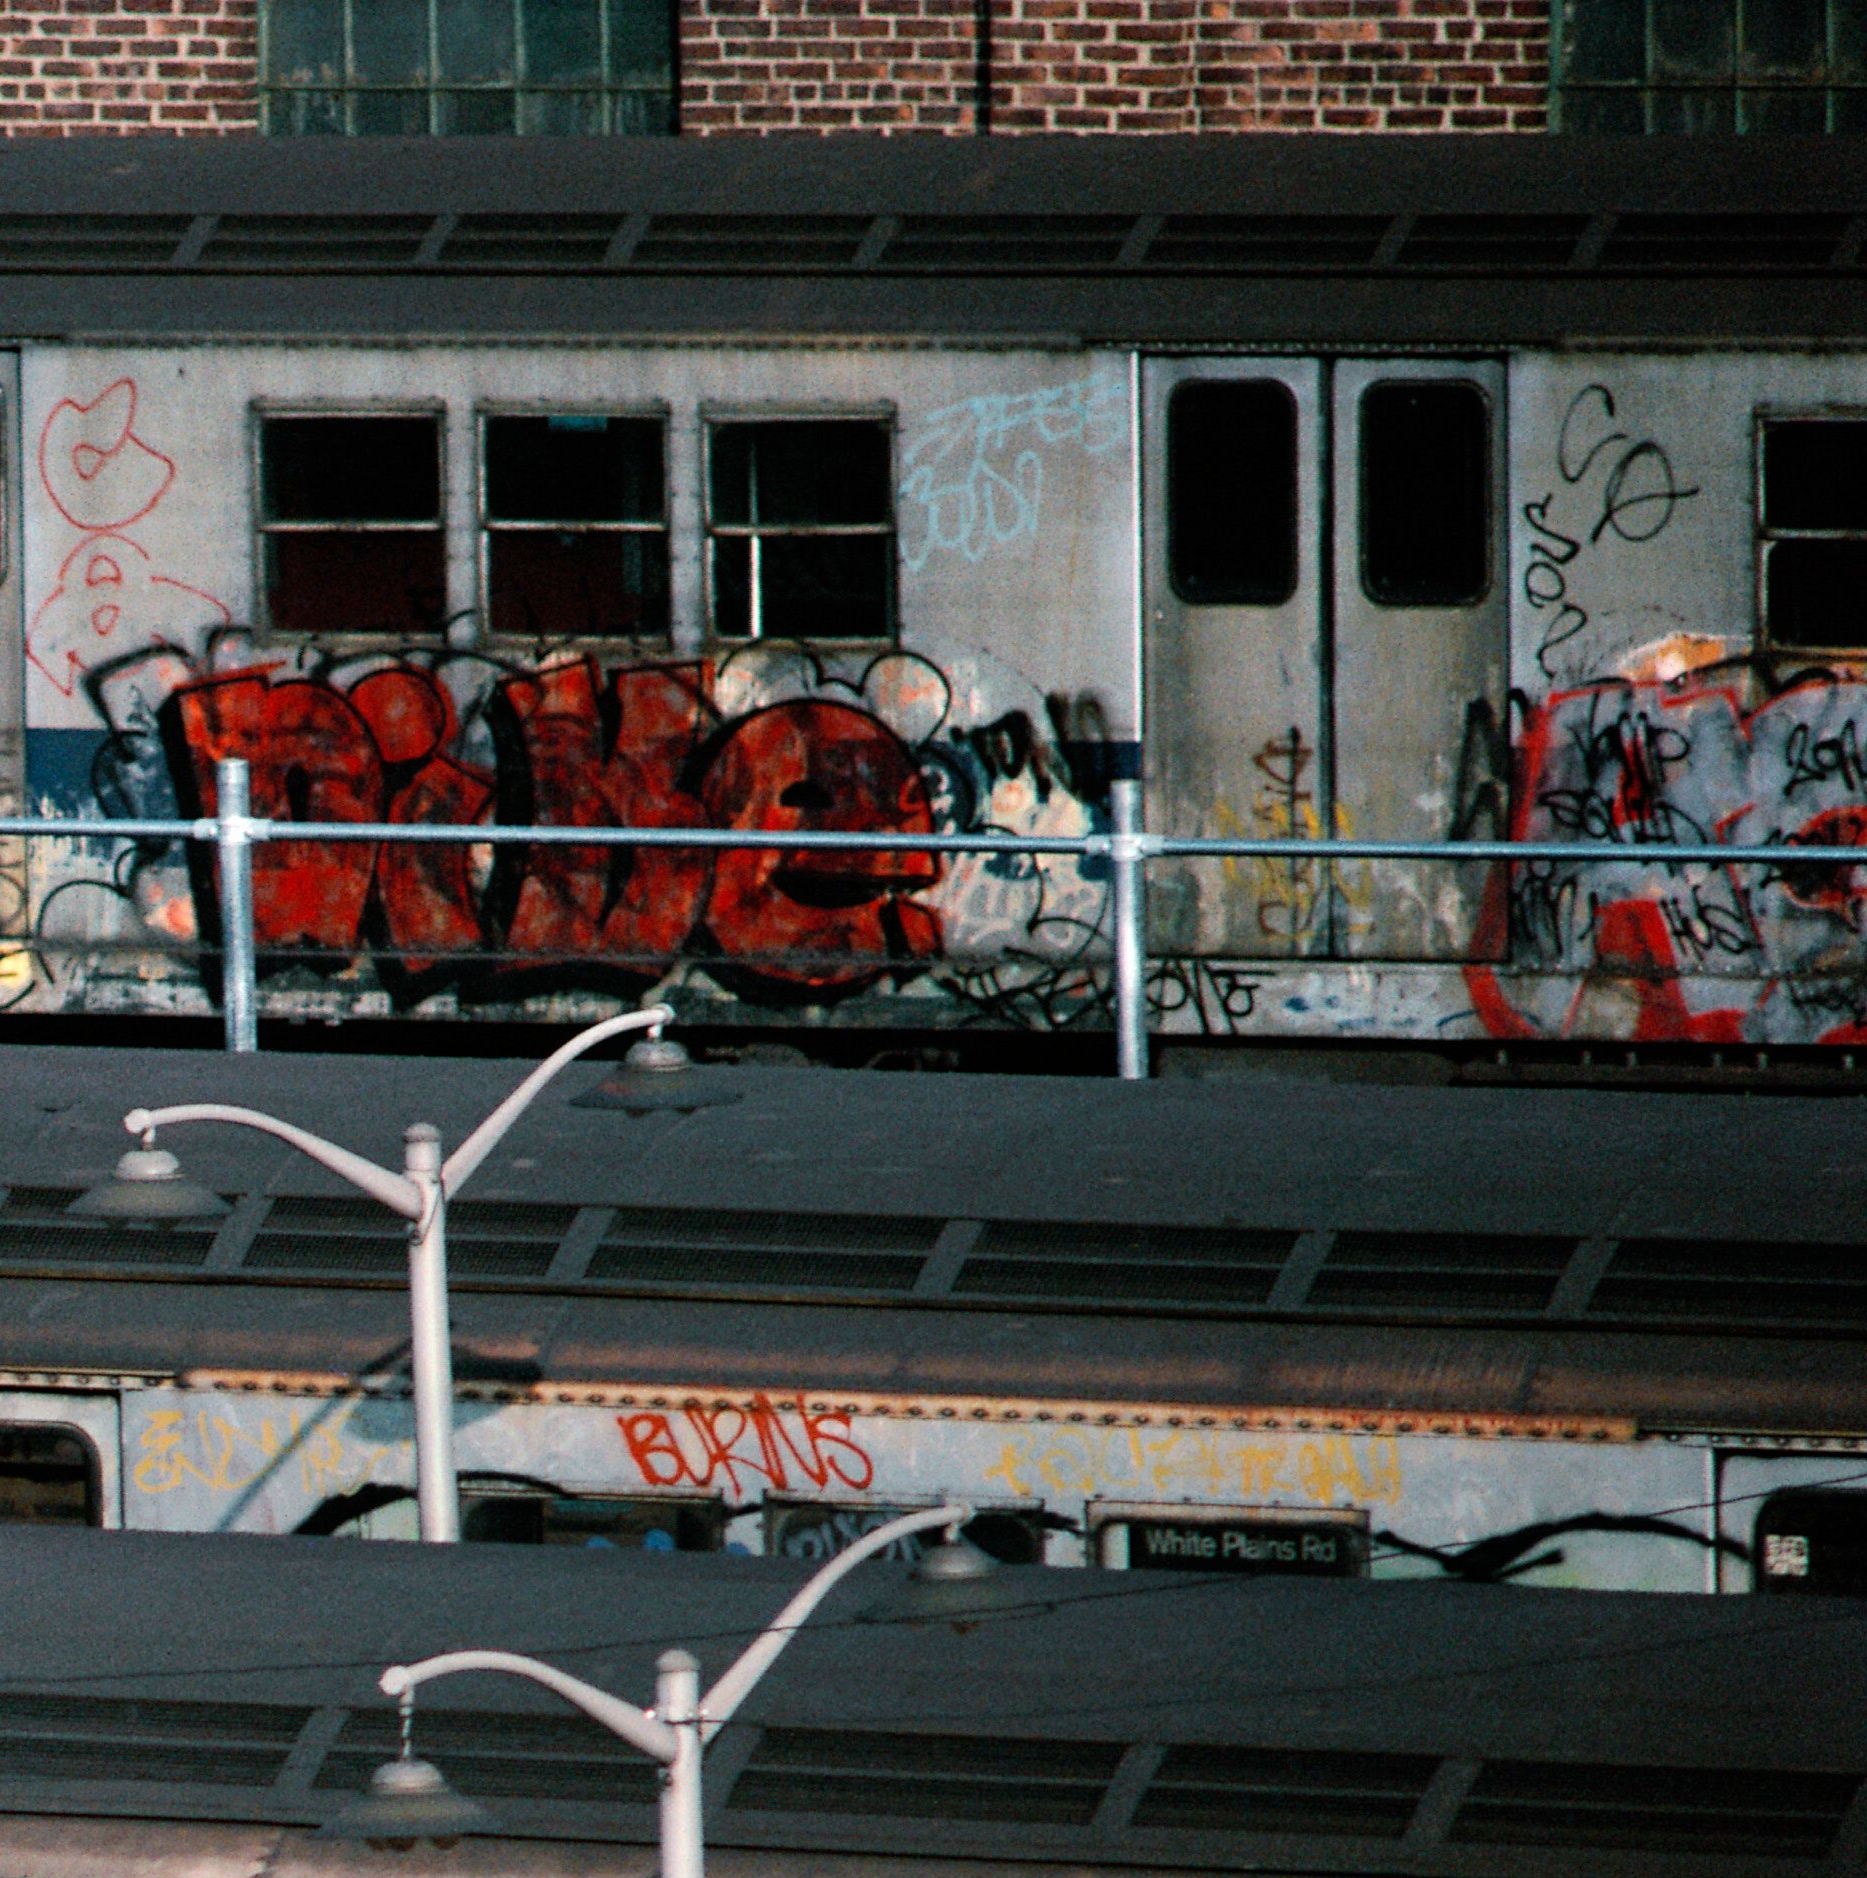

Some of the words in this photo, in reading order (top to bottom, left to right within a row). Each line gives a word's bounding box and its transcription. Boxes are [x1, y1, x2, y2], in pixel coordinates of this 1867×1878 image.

[617, 1392, 874, 1500] BURNS
[1146, 1529, 1216, 1558] White
[1223, 1531, 1298, 1562] Plains
[1301, 1535, 1337, 1563] Rd
